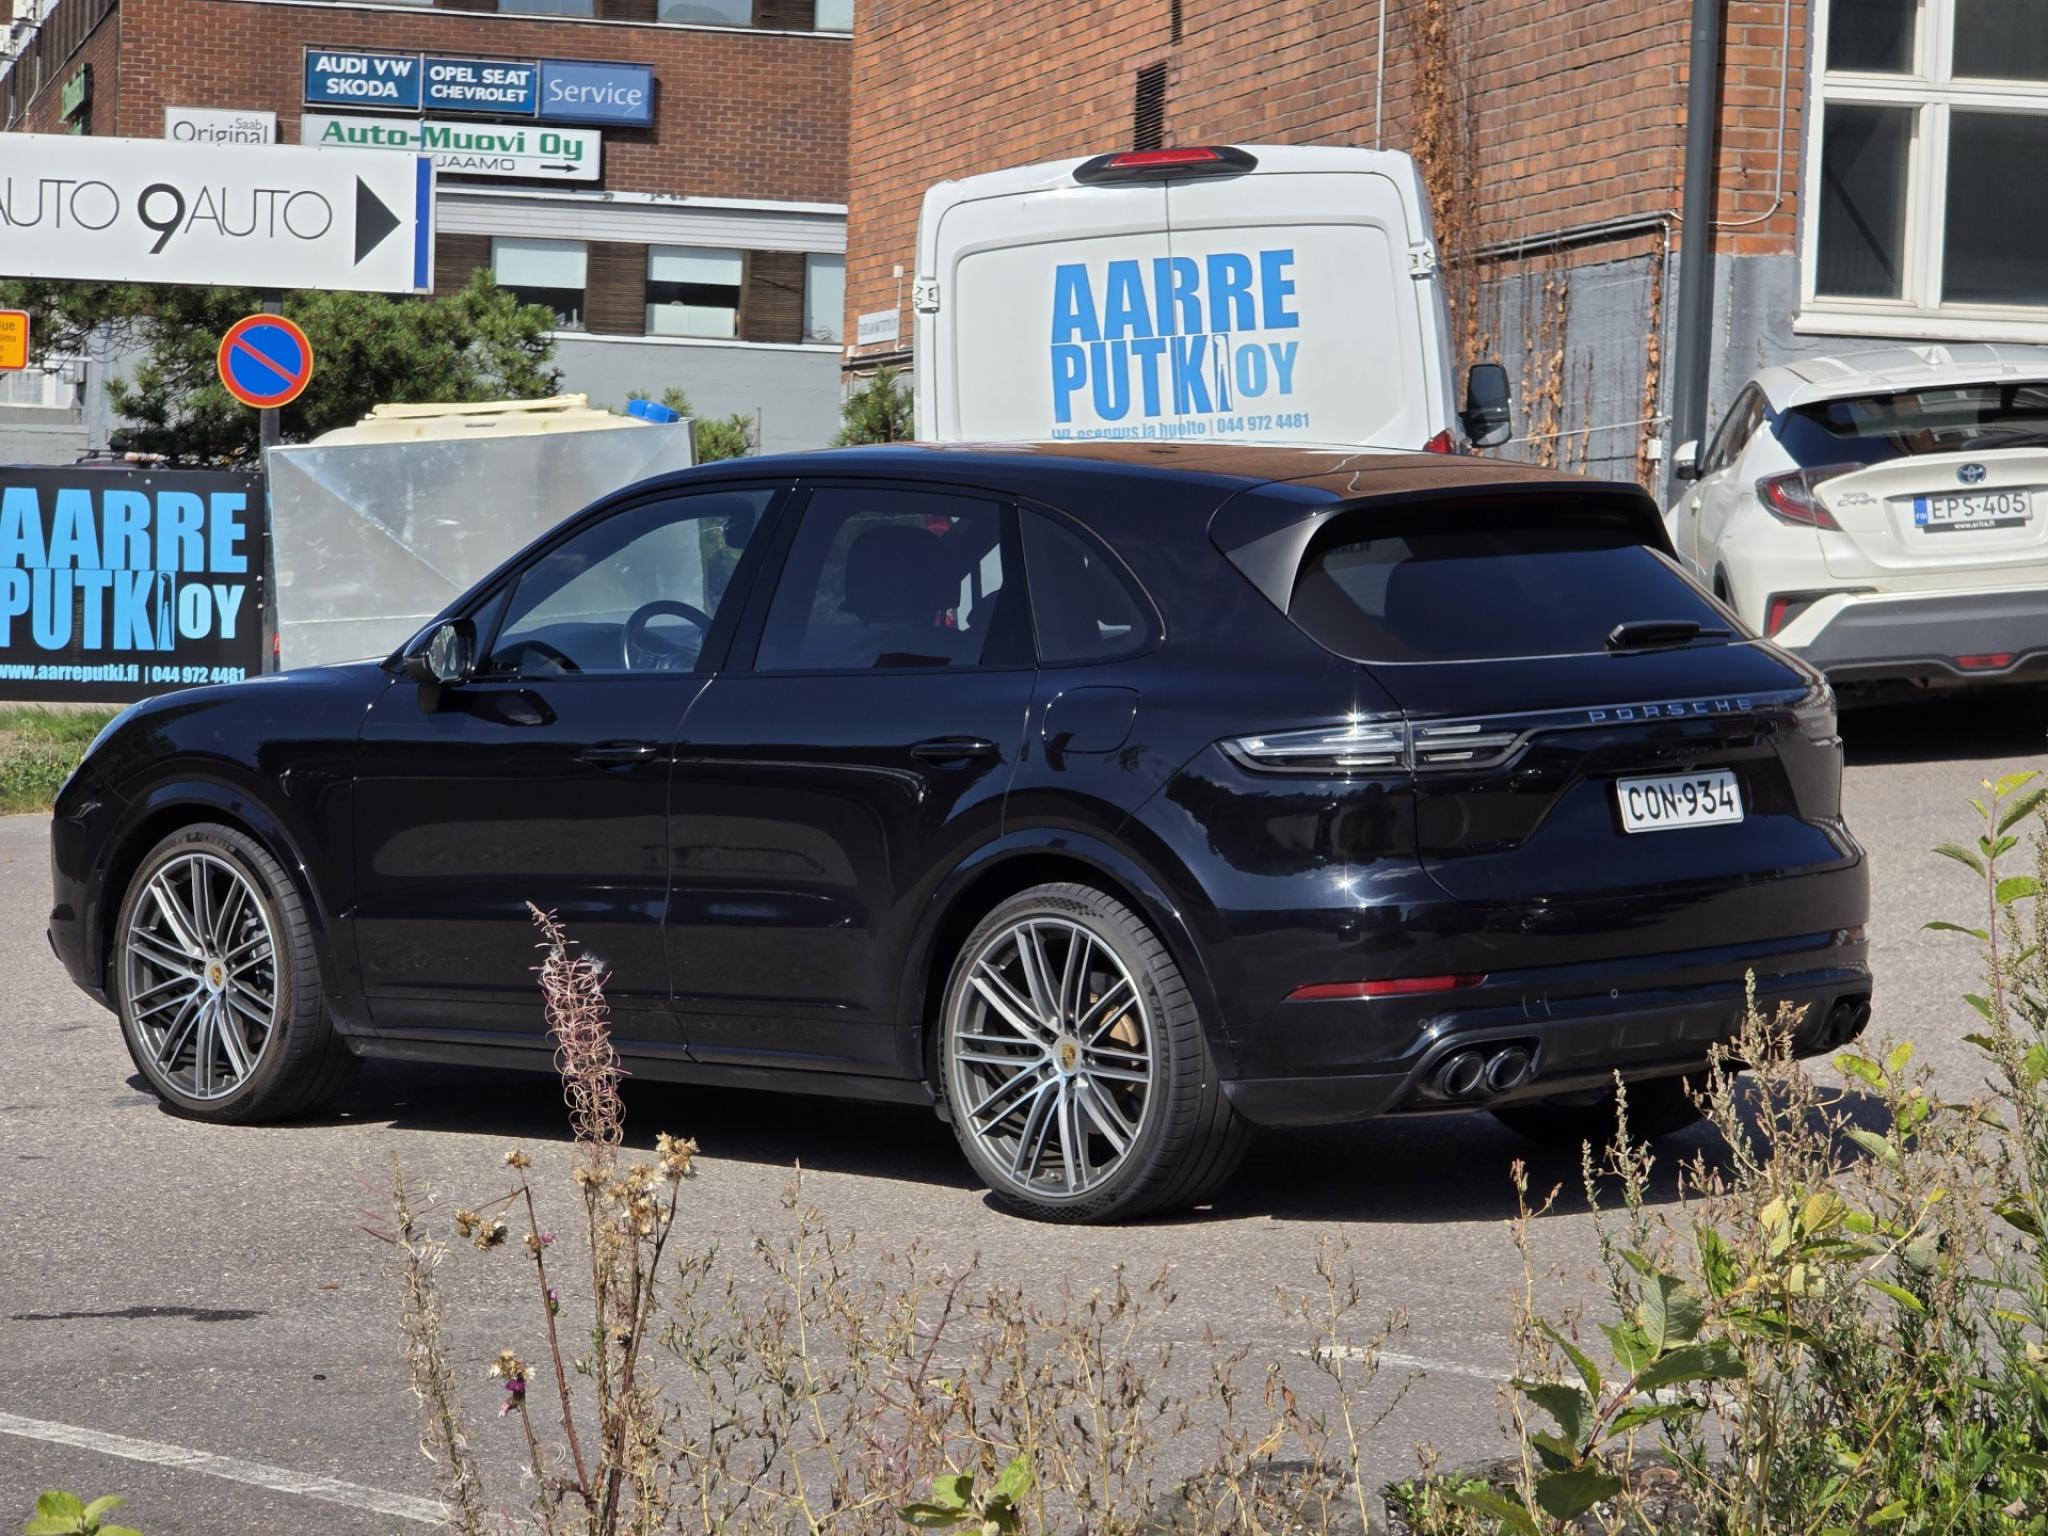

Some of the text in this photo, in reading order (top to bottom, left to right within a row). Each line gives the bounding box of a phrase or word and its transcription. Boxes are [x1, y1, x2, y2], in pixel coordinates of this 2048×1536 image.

[315, 56, 413, 77] AUDI VW
[429, 65, 530, 87] OPEL SEAT
[326, 78, 399, 98] SKODA
[430, 86, 528, 104] CHEVROLET
[550, 80, 642, 107] Service
[173, 120, 268, 144] Original
[235, 117, 262, 130] Saab
[321, 121, 584, 162] Auto-Muovi Oy
[436, 156, 515, 171] JAAMO
[1051, 249, 1300, 345] AARRE
[1051, 333, 1299, 424] PUTKI OY
[1160, 420, 1206, 438] huolto
[1217, 417, 1244, 433] 044
[1247, 415, 1272, 431] 972
[1275, 413, 1310, 429] 4481
[1931, 494, 2026, 520] EPS-405
[0, 487, 248, 573] AARRE
[0, 567, 246, 651] PUTKI OY
[0, 664, 245, 684] www.aarreputki.fi 044 972 4481
[1588, 699, 1754, 724] PORSCHE
[1628, 778, 1735, 822] CON-934
